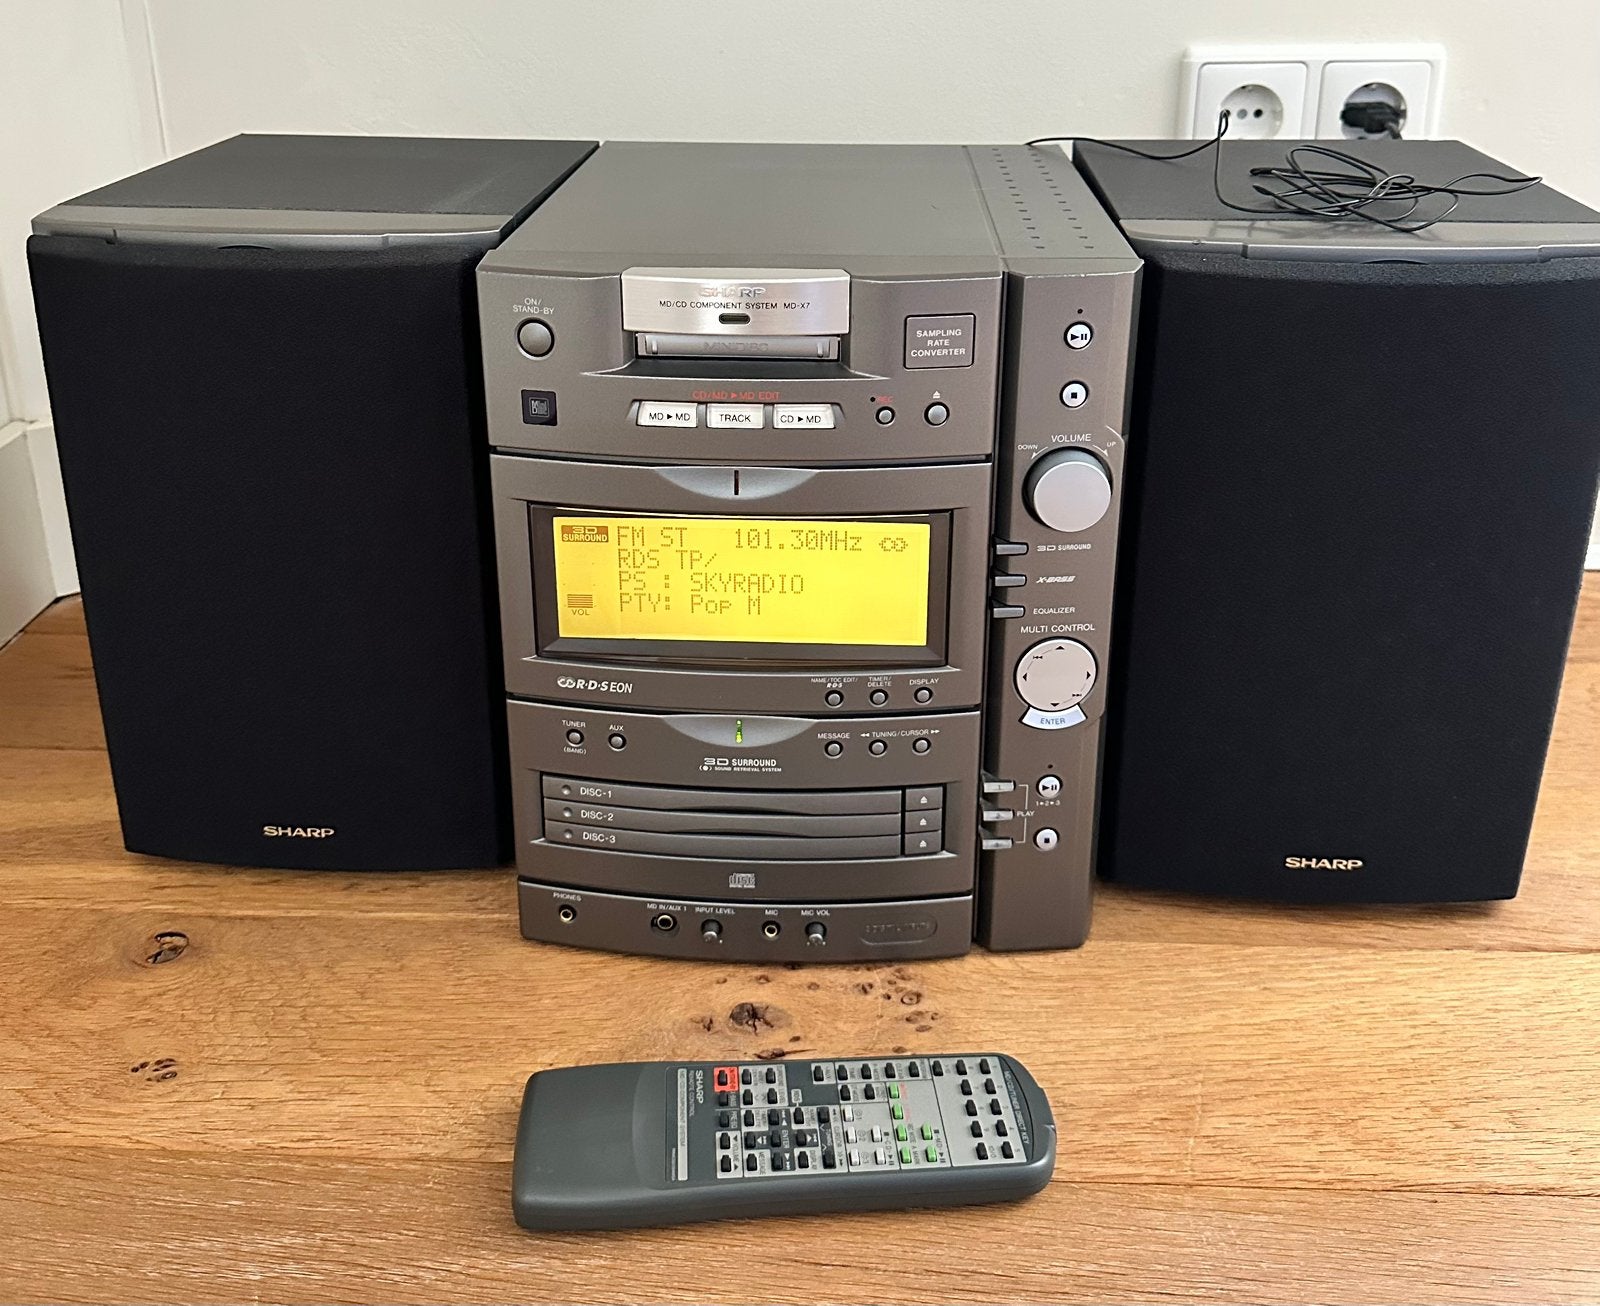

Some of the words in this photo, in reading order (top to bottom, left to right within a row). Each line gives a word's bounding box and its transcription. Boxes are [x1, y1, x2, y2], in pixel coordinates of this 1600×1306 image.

[700, 287, 766, 298] SHARP
[660, 300, 686, 309] MD/CD
[512, 305, 554, 314] STAND-BY
[916, 328, 962, 338] SAMPLING
[910, 348, 966, 357] CONVERTER
[692, 391, 728, 400] CD/MD
[739, 392, 754, 400] MD
[758, 392, 780, 400] EDIT
[648, 412, 664, 420] MD
[676, 413, 690, 421] MD
[720, 414, 751, 422] TRACK
[780, 415, 794, 423] CD
[806, 415, 822, 423] MD
[1051, 434, 1092, 443] VOLUME
[562, 534, 608, 542] SURROUND
[617, 526, 644, 546] FM
[660, 526, 688, 547] ST
[736, 528, 862, 551] 101.30MHz
[618, 548, 660, 568] RDS
[676, 550, 717, 570] TP/
[619, 570, 646, 590] PS
[690, 572, 804, 594] SKYRADIO
[1036, 575, 1076, 584] X-BASS
[620, 592, 670, 612] PTY:
[748, 595, 760, 615] M
[1033, 606, 1076, 614] EQUALIZER
[1020, 626, 1048, 634] MULTI
[1051, 624, 1096, 632] CONTROL
[562, 720, 586, 728] TUNER
[1040, 717, 1066, 725] ENTER
[564, 746, 586, 754] (BAND)
[704, 758, 729, 766] 3D
[732, 758, 777, 766] SURROUND
[580, 786, 612, 798] DISC-1
[580, 810, 614, 822] DISC-2
[263, 826, 334, 838] SHARP
[582, 832, 616, 844] DISC-3
[1285, 857, 1363, 870] SHARP
[553, 892, 582, 902] PHONES
[1021, 1132, 1029, 1144] KEY
